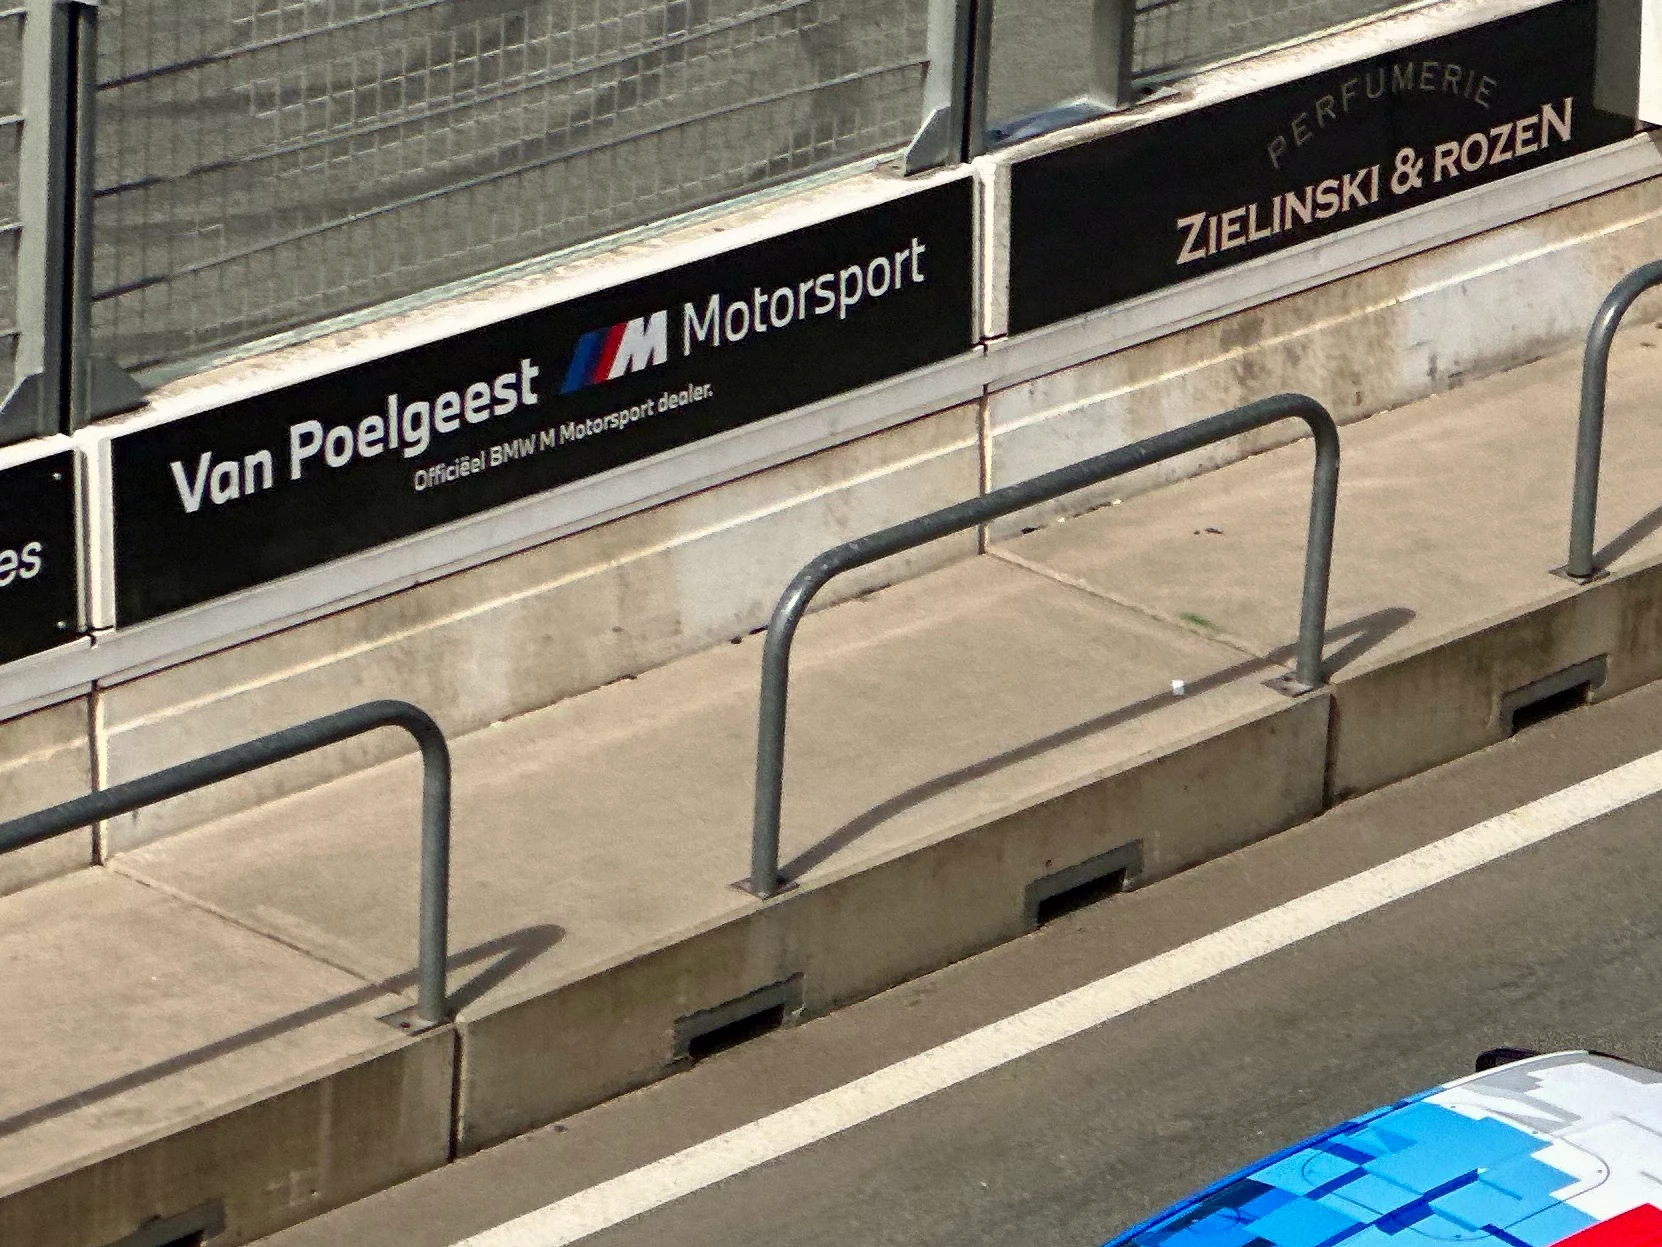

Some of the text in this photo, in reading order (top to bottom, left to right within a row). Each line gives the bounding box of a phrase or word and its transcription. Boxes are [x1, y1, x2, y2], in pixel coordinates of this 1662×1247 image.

[1176, 96, 1574, 265] ZIELINSKI & ROZEN
[1266, 61, 1498, 170] PERFUMERIE
[170, 448, 273, 514] Van
[290, 358, 540, 480] Poelgeest
[682, 236, 927, 357] Motorsport
[413, 382, 714, 492] Officiëel BMW M Motorsport dealer.
